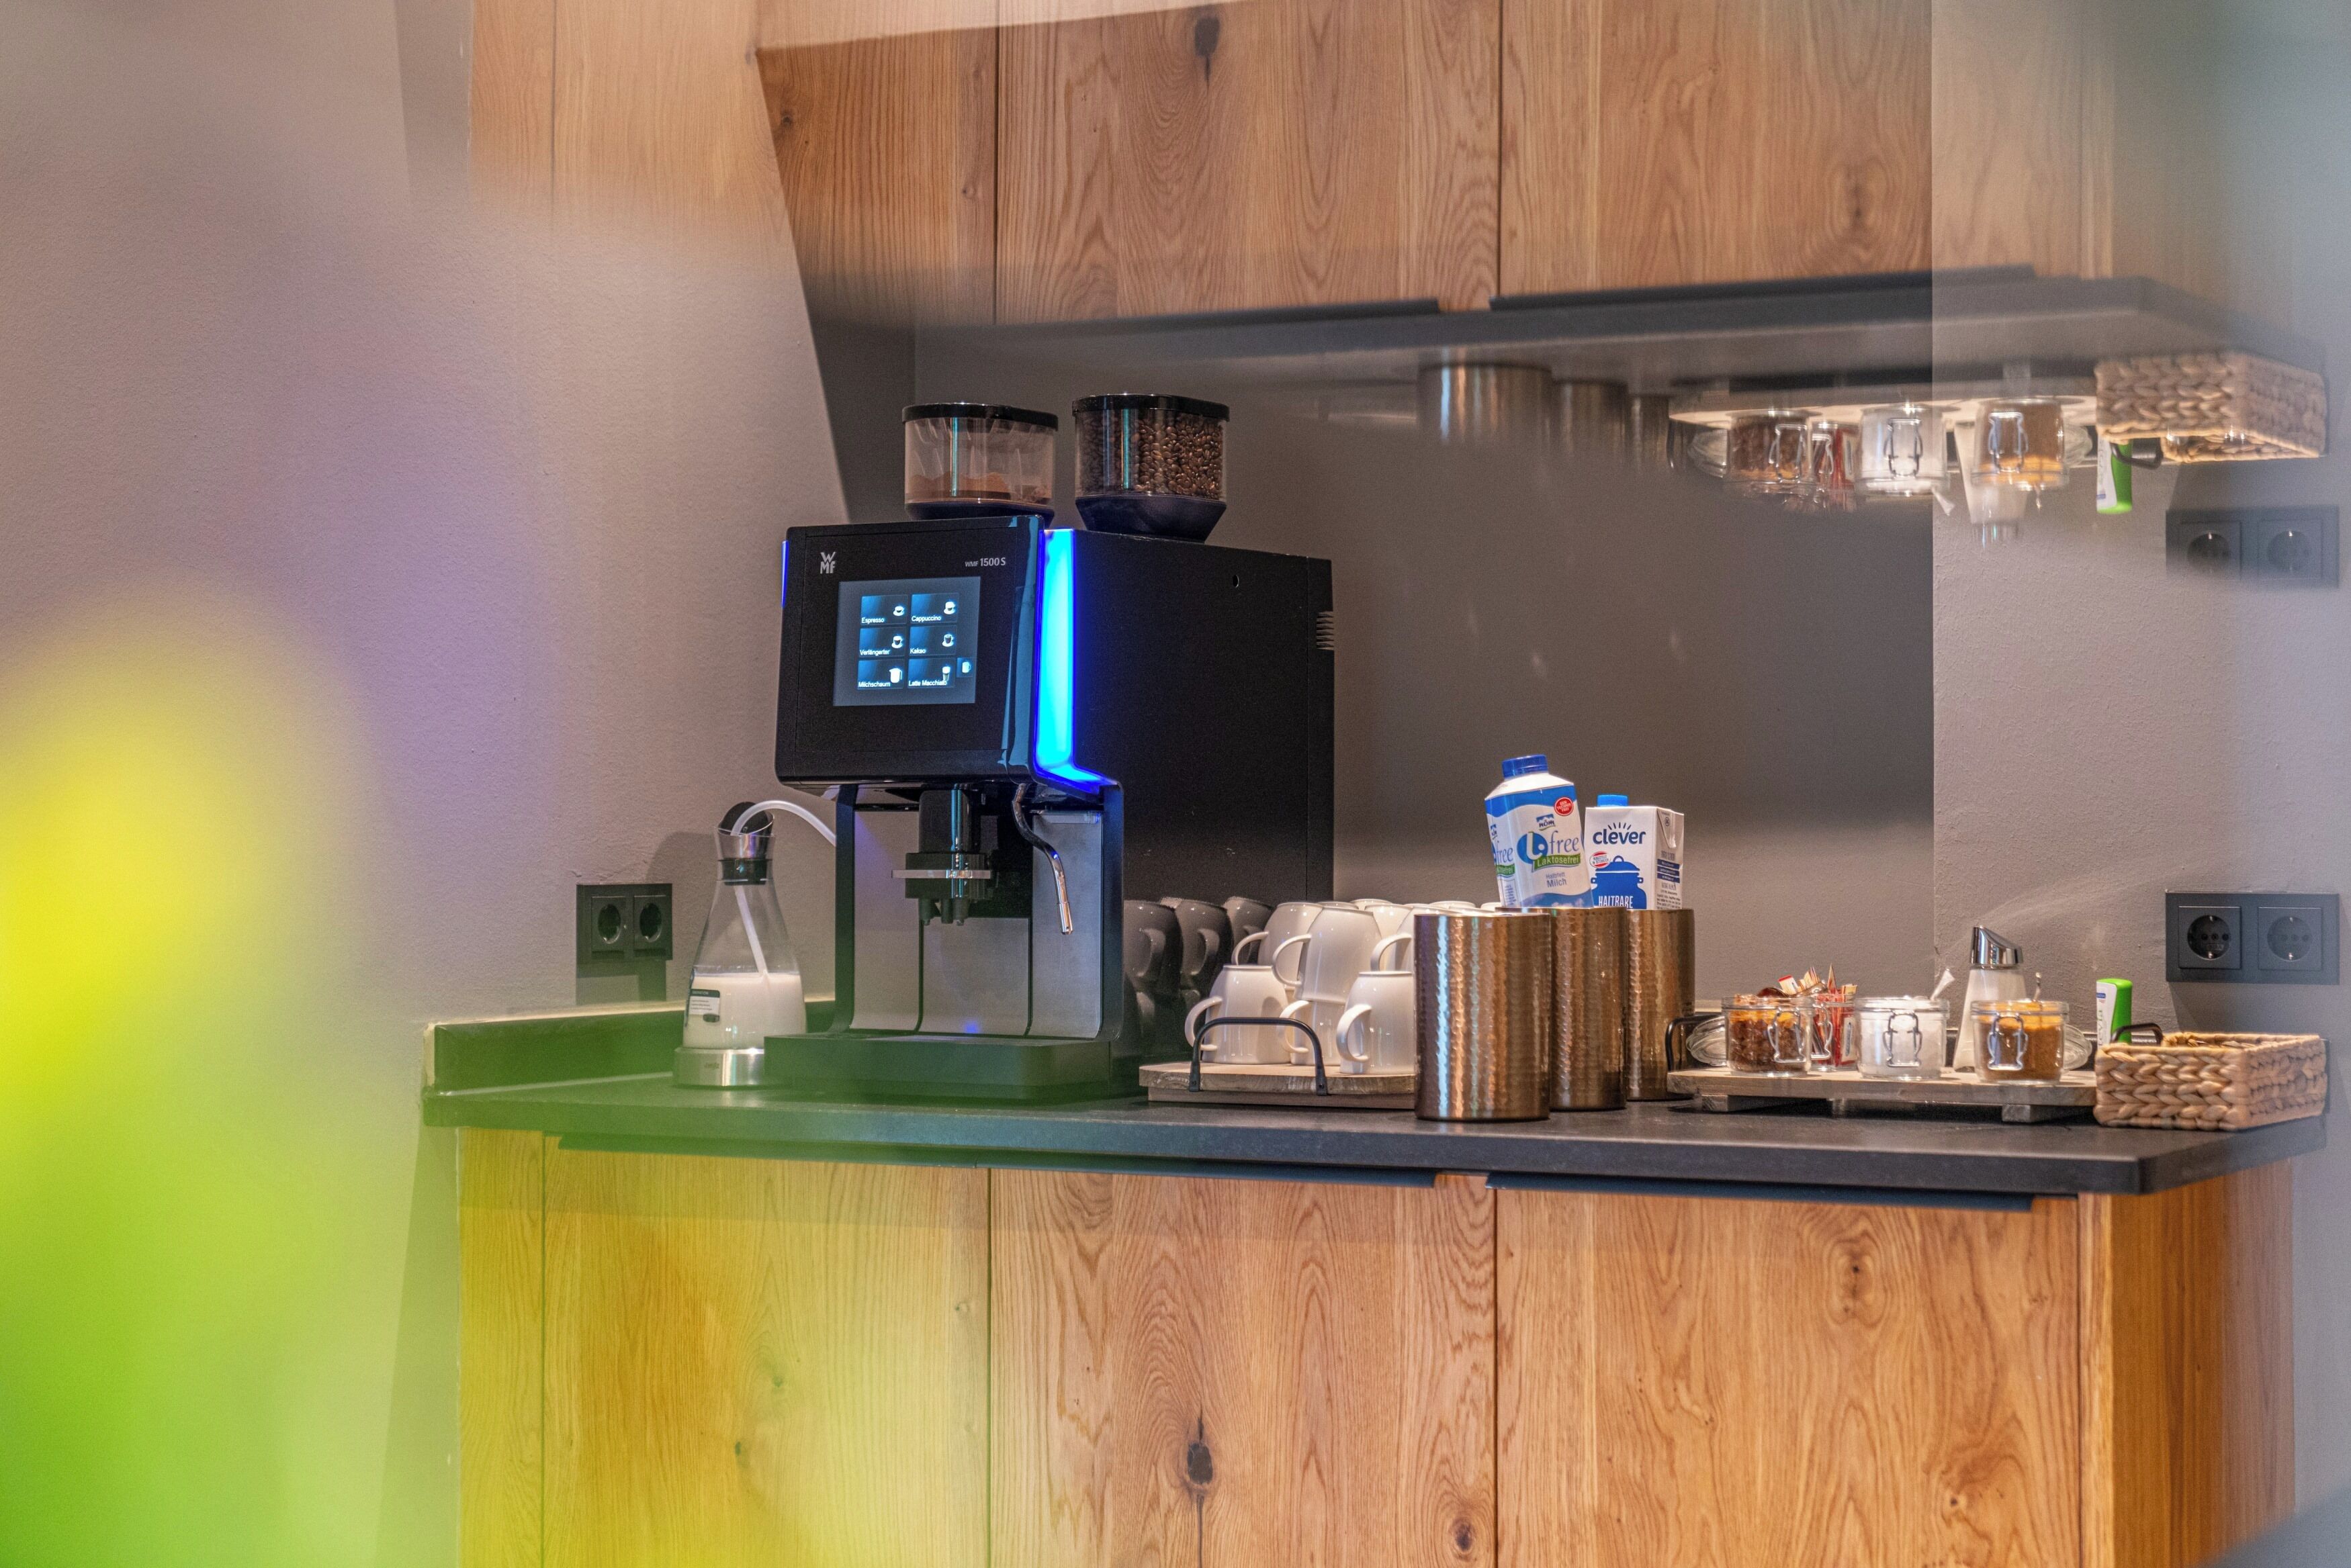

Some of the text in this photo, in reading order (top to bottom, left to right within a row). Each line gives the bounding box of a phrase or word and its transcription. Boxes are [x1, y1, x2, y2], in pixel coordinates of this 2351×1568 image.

[979, 557, 1000, 567] 1500
[1000, 557, 1006, 566] S
[1593, 828, 1646, 845] clever
[1549, 830, 1579, 855] free
[1537, 856, 1579, 867] Laktosefrei
[1547, 878, 1567, 888] Milch
